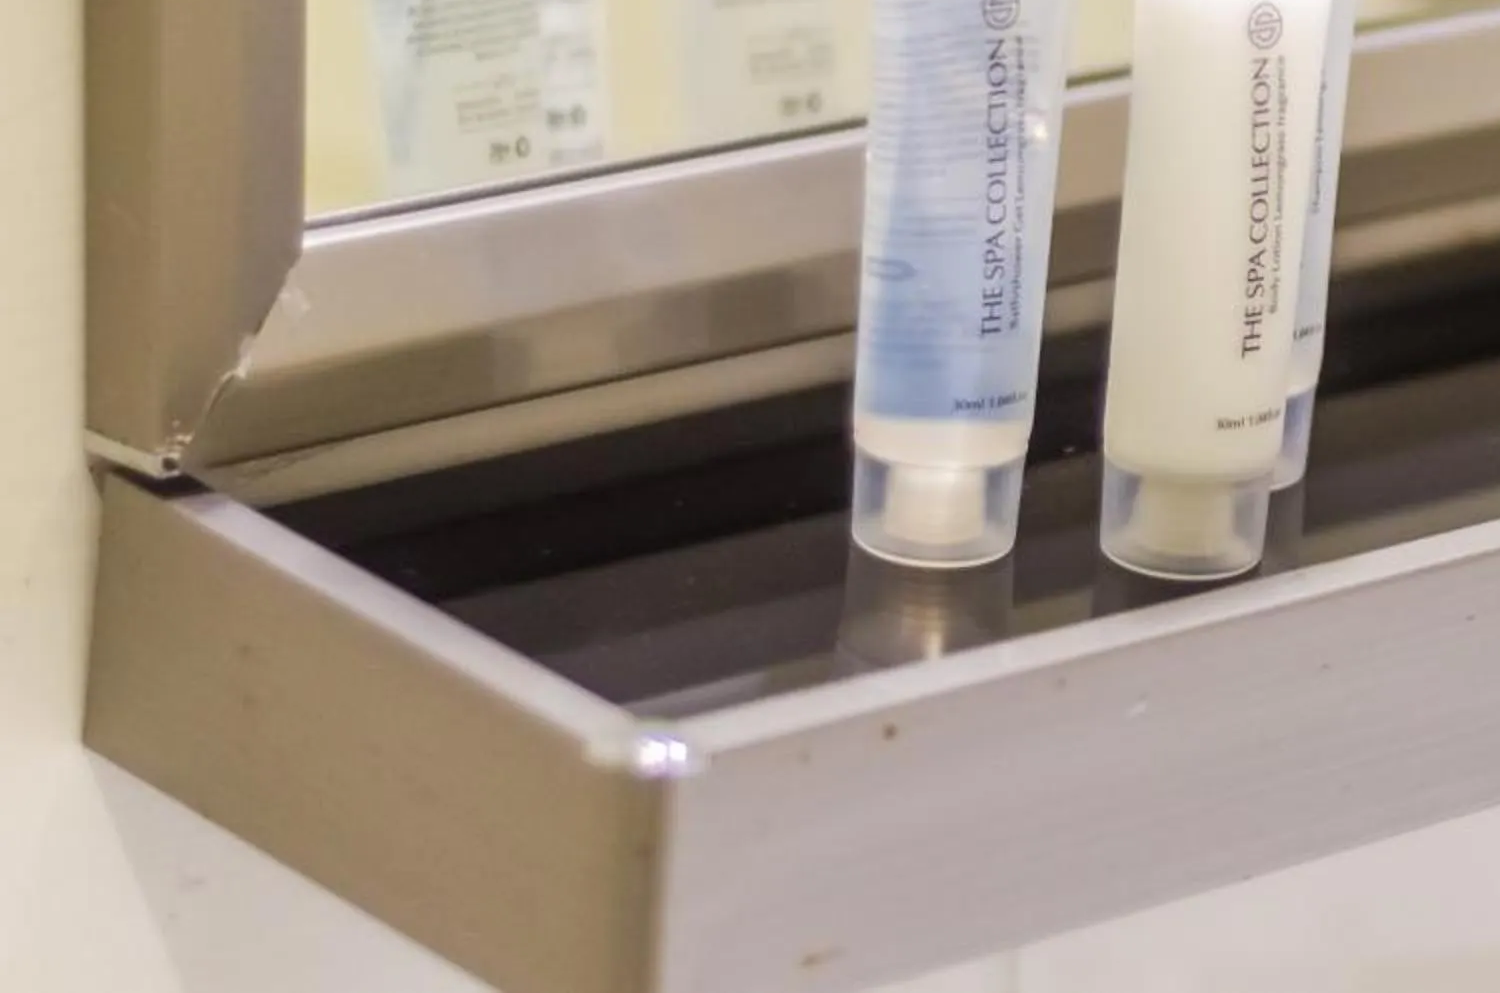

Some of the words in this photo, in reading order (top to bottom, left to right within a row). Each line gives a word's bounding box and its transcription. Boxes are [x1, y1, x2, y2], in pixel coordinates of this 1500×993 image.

[985, 39, 1009, 224] COLLECTION
[1248, 57, 1271, 245] COLLECTION
[983, 231, 1006, 280] SPA
[1244, 248, 1267, 299] SPA
[1270, 223, 1283, 273] Lotion
[981, 287, 1004, 337] THE
[1241, 305, 1264, 359] THE
